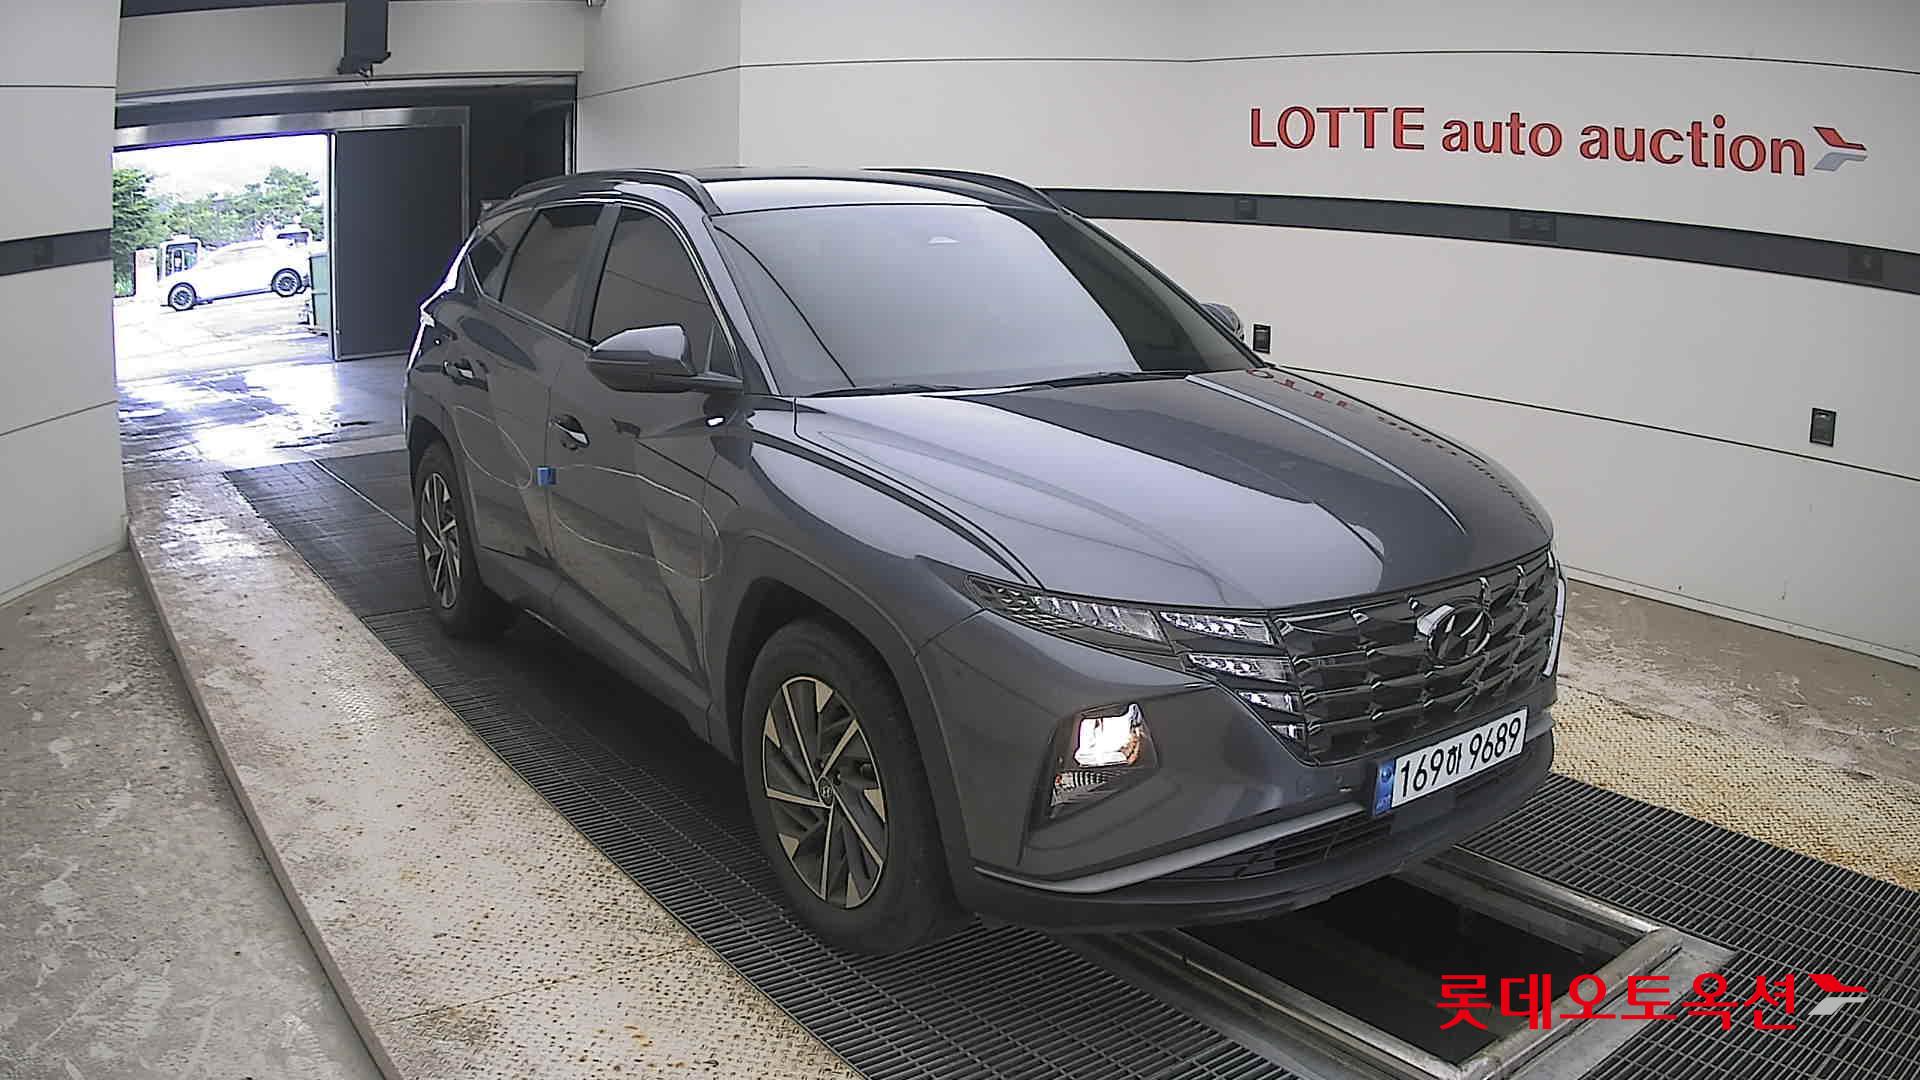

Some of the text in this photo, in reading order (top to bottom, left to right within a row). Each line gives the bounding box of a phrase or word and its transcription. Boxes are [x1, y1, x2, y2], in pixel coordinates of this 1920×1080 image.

[1250, 106, 1806, 176] LOTTE auto auction
[1400, 717, 1521, 798] 169하 9689
